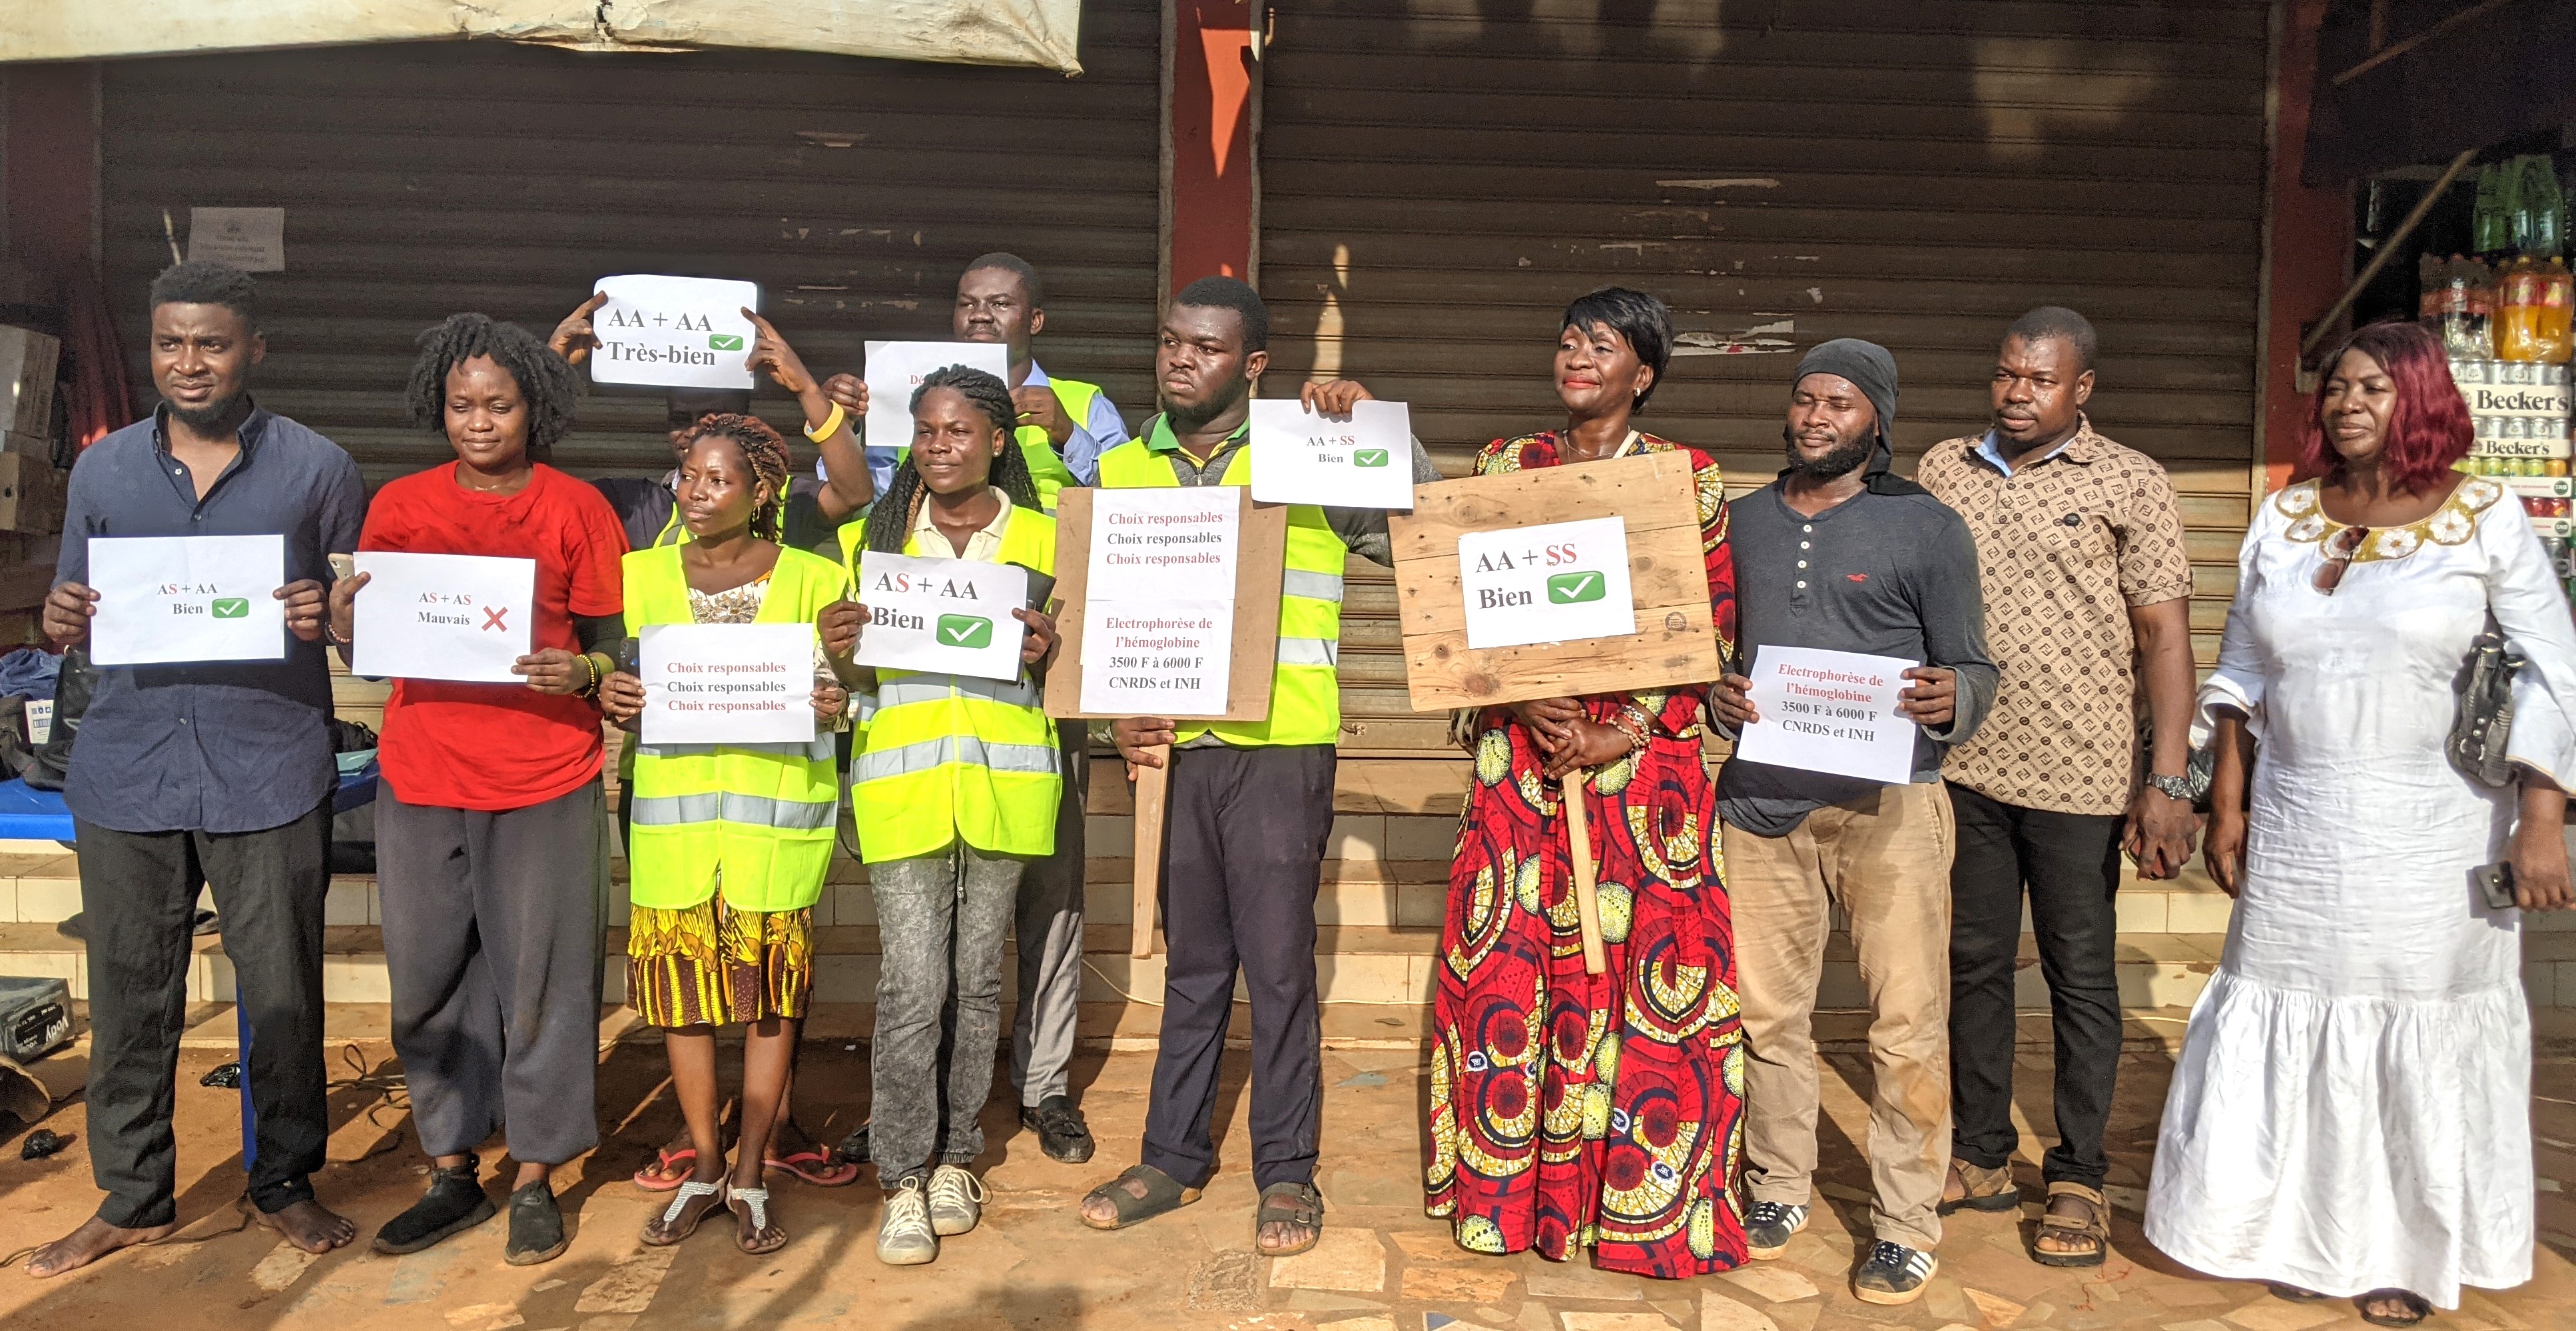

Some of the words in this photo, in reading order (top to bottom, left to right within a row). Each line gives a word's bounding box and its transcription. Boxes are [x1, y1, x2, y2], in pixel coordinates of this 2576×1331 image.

[608, 308, 645, 327] AA
[653, 312, 668, 326] +
[675, 313, 713, 331] AA
[607, 342, 715, 365] Très-bien
[1307, 437, 1325, 446] AA
[1341, 436, 1355, 445] SS
[1109, 514, 1143, 524] Choix
[1148, 512, 1222, 526] responsables
[1108, 534, 1142, 544] Choix
[1147, 532, 1221, 546] responsables
[1107, 554, 1141, 564] Choix
[1145, 552, 1220, 566] responsables
[1476, 551, 1515, 573] AA
[1522, 550, 1538, 565] +
[1546, 544, 1576, 566] SS
[158, 584, 177, 594] AS
[182, 584, 190, 593] +
[196, 584, 217, 594] AA
[874, 572, 908, 592] AS
[918, 578, 932, 592] +
[940, 579, 978, 600] AA
[419, 593, 437, 603] AS
[453, 595, 471, 605] AS
[1478, 588, 1533, 609] Bien
[174, 604, 202, 614] Bien
[418, 612, 470, 625] Mauvais
[871, 607, 924, 630] Bien
[1106, 618, 1195, 632] Electrophorèse
[1199, 618, 1212, 628] de
[1116, 636, 1199, 650] l'hémoglobine
[667, 663, 703, 673] Choix
[708, 662, 786, 675] responsables
[1110, 657, 1137, 667] 3500
[1141, 658, 1149, 667] F
[1153, 657, 1159, 667] à
[1163, 658, 1190, 668] 6000
[1195, 658, 1203, 668] F
[1779, 664, 1865, 684] Electrophorèse
[1869, 675, 1883, 686] de
[667, 681, 703, 691] Choix
[709, 681, 785, 694] responsables
[1110, 677, 1156, 688] CNRDS
[1160, 679, 1171, 688] et
[1175, 678, 1201, 689] INH
[1787, 683, 1871, 702] l'hémoglobine
[669, 700, 703, 710] Choix
[709, 701, 785, 713] responsables
[1781, 701, 1809, 713] 3500
[1814, 705, 1821, 714] F
[1826, 706, 1832, 716] à
[1836, 707, 1864, 720] 6000
[1869, 711, 1877, 721] F
[1783, 720, 1829, 735] CNRDS
[1833, 728, 1844, 737] et
[1848, 728, 1875, 741] INH
